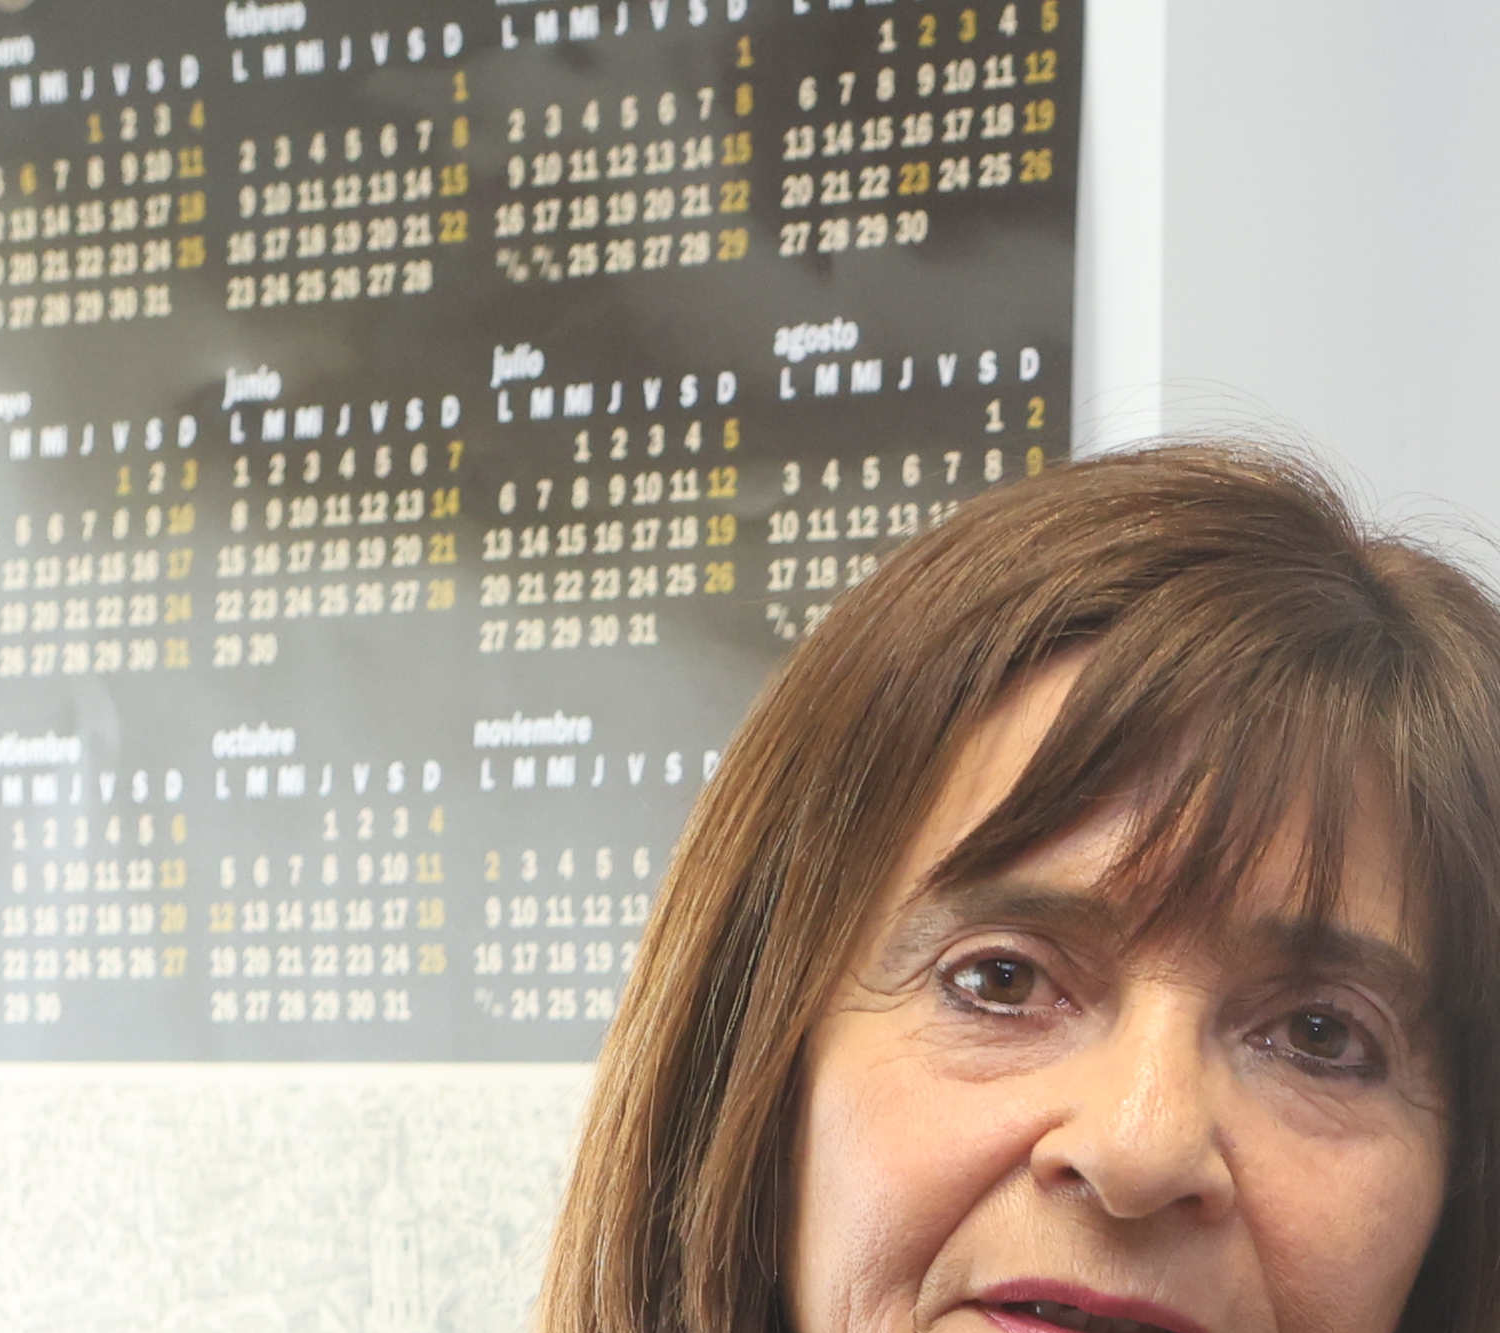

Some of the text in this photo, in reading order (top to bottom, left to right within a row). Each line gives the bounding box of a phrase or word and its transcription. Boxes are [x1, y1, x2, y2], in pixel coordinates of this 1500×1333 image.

[878, 0, 1058, 54] 1 2 3 4 5
[798, 49, 1057, 110] 6 7 8 9 10 11 12
[781, 148, 1052, 209] 20 21 22 23 24 25 26
[772, 316, 860, 364] agosto
[223, 364, 281, 410] junio
[489, 343, 545, 389] julio
[780, 347, 1040, 399] L M Mi J V S D
[211, 722, 296, 759] octubre
[473, 710, 593, 748] noviembre
